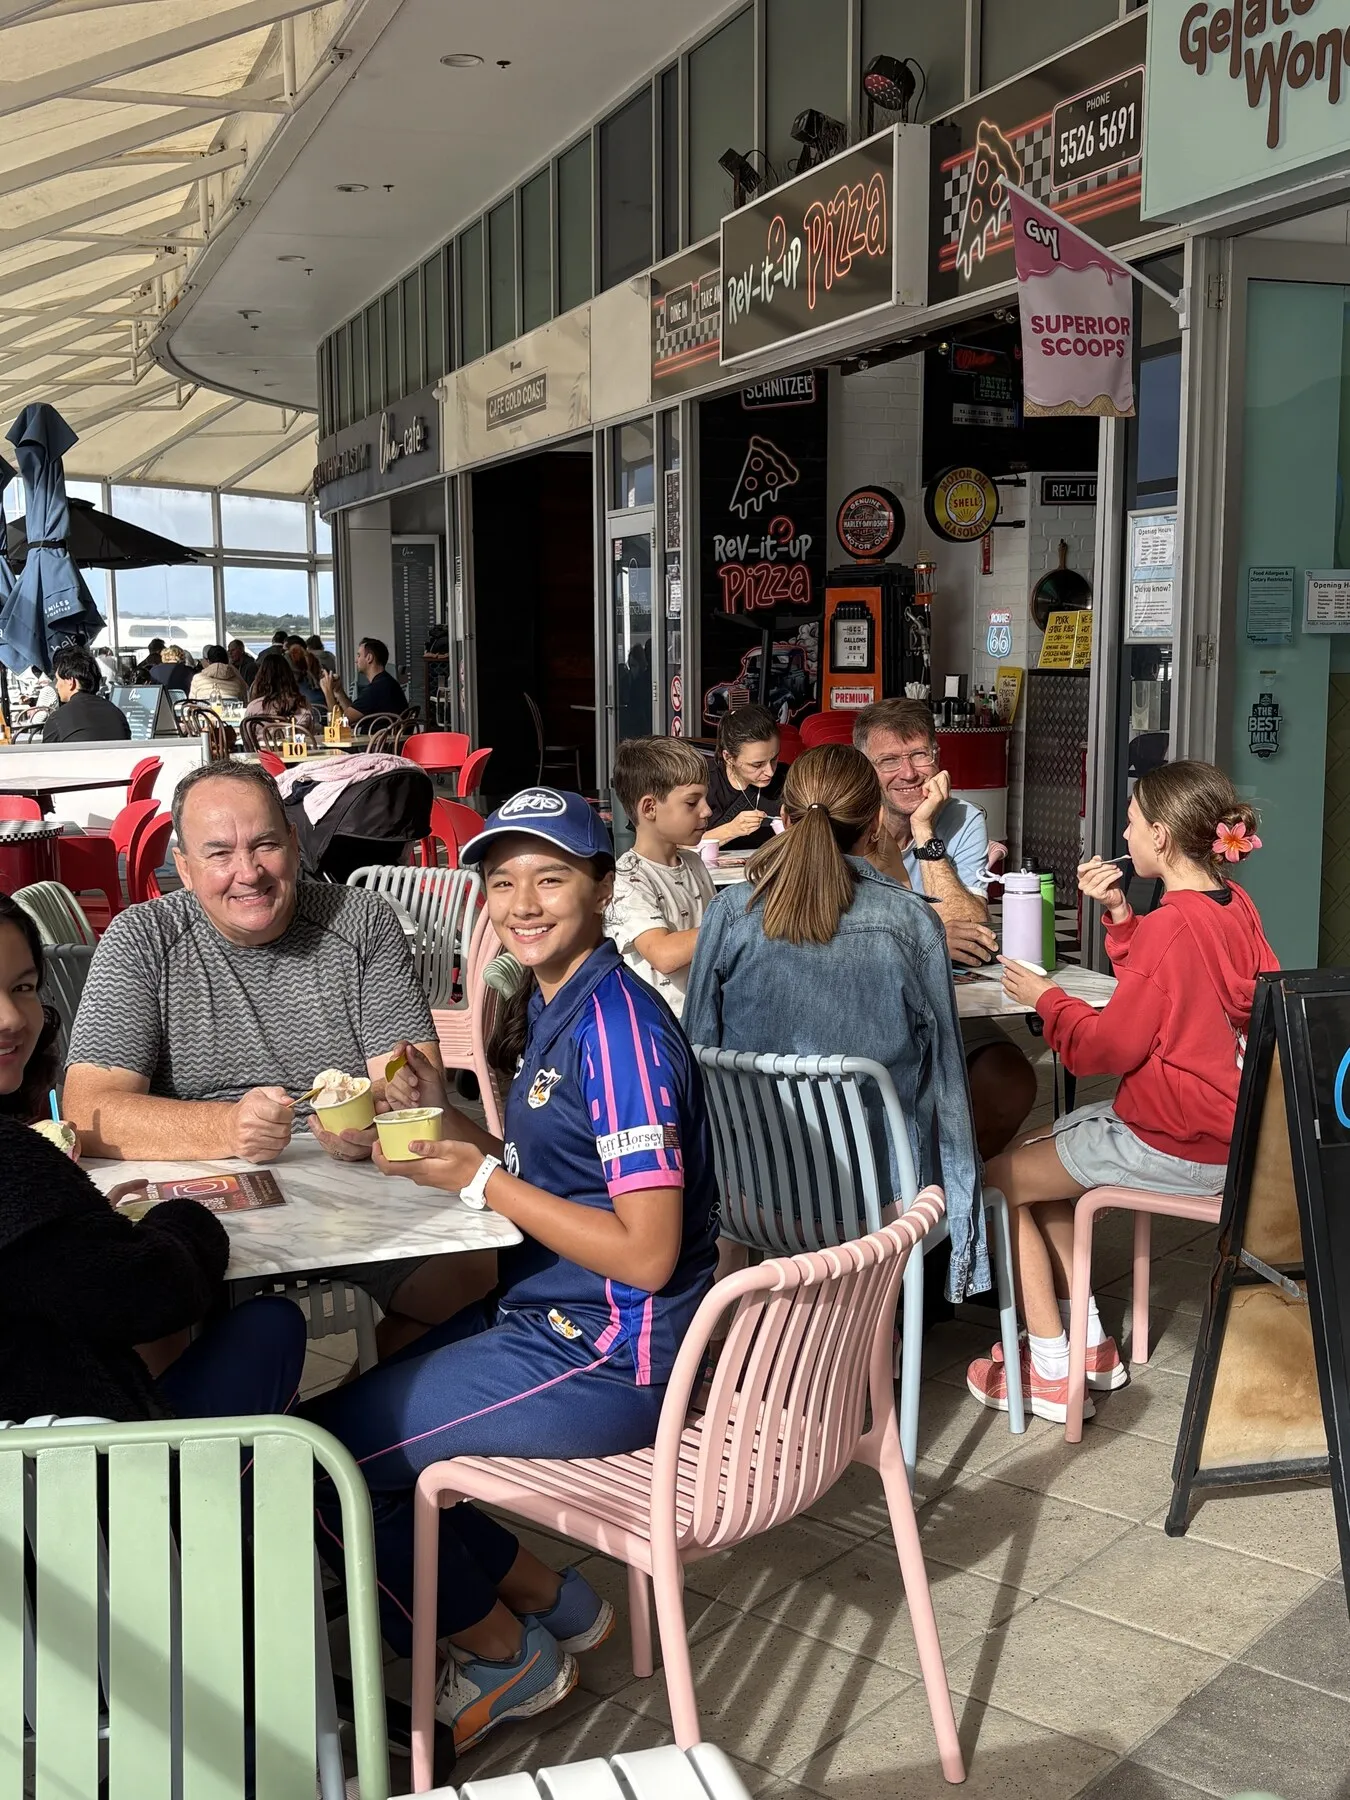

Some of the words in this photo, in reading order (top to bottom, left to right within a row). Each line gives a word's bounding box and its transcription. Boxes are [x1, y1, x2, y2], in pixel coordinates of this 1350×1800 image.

[1244, 25, 1350, 149] Won
[1086, 91, 1111, 112] PHONE
[1060, 121, 1094, 168] 5526
[1099, 102, 1135, 151] 5691
[803, 171, 887, 310] Pizza
[701, 287, 713, 310] TAKE
[1031, 315, 1130, 336] SUPERIOR
[1041, 338, 1125, 358] SCOOPS
[489, 397, 503, 419] CAFE
[504, 389, 521, 412] GOLD
[522, 379, 545, 407] COAST
[940, 469, 973, 493] MOTOR
[974, 472, 989, 490] OIL
[1052, 484, 1086, 497] REV-IT
[1089, 484, 1097, 497] U
[850, 498, 882, 511] GENUINE
[953, 498, 979, 508] SHELL
[944, 516, 989, 537] GASOLINE
[845, 533, 871, 550] MOTOR
[873, 533, 889, 546] OIL
[718, 562, 810, 614] Pizza
[1151, 583, 1172, 593] know?
[1055, 615, 1070, 625] PORK
[991, 628, 1008, 653] 66
[835, 692, 870, 704] PREMIUM
[1257, 706, 1273, 716] THE
[329, 728, 335, 738] 9
[1249, 717, 1282, 731] BEST
[1252, 732, 1277, 743] MILK
[288, 744, 303, 756] 10
[598, 1138, 616, 1159] Jeff
[617, 1131, 662, 1149] Horsey
